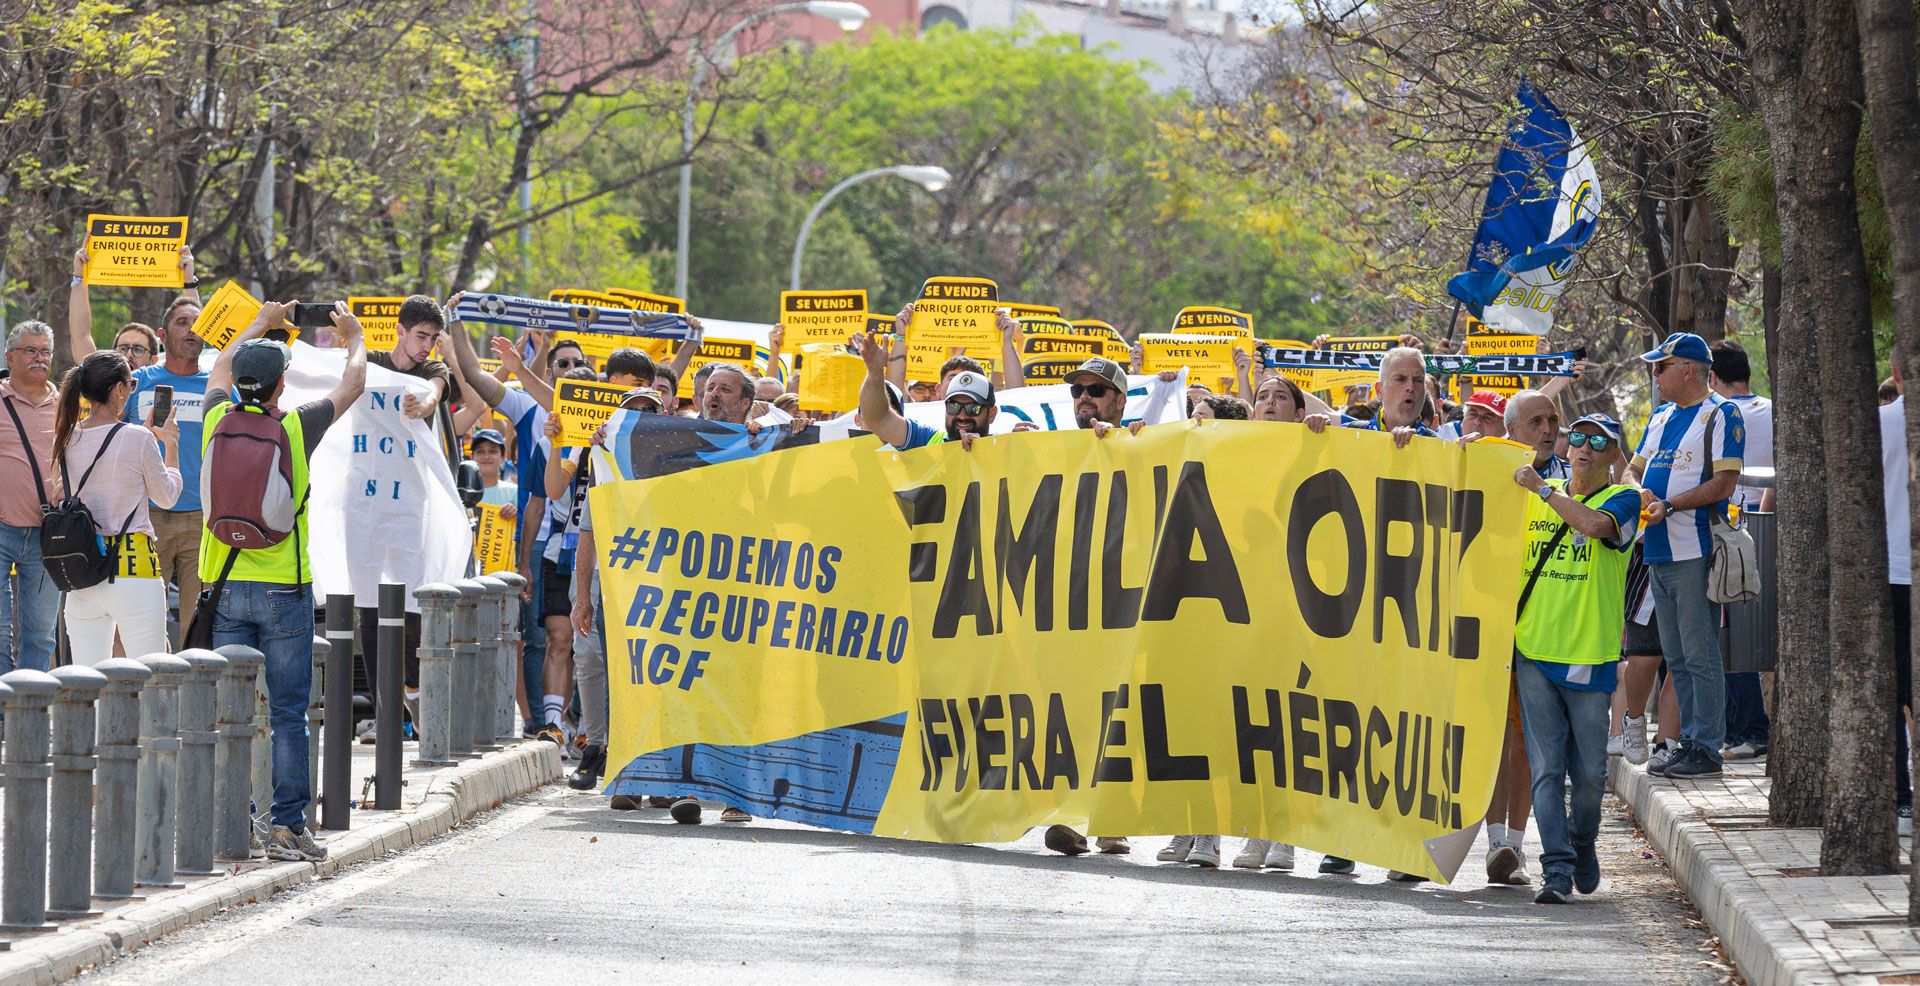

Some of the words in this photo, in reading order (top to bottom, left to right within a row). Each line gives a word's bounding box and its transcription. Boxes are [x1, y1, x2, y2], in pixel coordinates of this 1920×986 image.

[104, 223, 120, 234] SE
[124, 224, 170, 235] VENDE
[93, 241, 141, 252] ENRIQUE
[145, 242, 177, 252] ORTIZ
[112, 256, 140, 265] VETE
[141, 257, 156, 265] YA
[924, 285, 940, 297] SE
[943, 286, 989, 297] VENDE
[796, 299, 811, 309] SE
[813, 298, 854, 309] VENDE
[914, 304, 962, 314] ENRIQUE
[965, 305, 997, 314] ORTIZ
[363, 305, 377, 315] SE
[788, 316, 832, 325] ENRIQUE
[834, 315, 863, 323] ORTIZ
[934, 318, 959, 327] VETE
[963, 319, 977, 327] YA
[1180, 315, 1194, 325] SE
[1197, 314, 1239, 325] VENDE
[806, 328, 829, 336] VETE
[831, 328, 845, 336] YA
[877, 323, 892, 332] SE
[1031, 323, 1070, 335] VENDE
[1034, 341, 1048, 351] SE
[1051, 343, 1092, 353] VENDE
[1330, 343, 1344, 351] SE
[1347, 341, 1388, 350] VENDE
[1470, 340, 1508, 349] ENRIQUE
[1510, 340, 1534, 348] ORTIZ
[701, 345, 741, 357] VENDE
[1194, 350, 1209, 358] YA
[910, 355, 923, 363] YA
[1478, 357, 1564, 373] SUR
[1032, 366, 1047, 376] SE
[1481, 377, 1518, 386] VENDE
[573, 388, 590, 400] SE
[560, 405, 612, 420] ENRIQUE
[581, 422, 599, 431] VE
[484, 510, 495, 535] ORTIZ
[496, 528, 504, 540] YA
[491, 541, 502, 563] VETE
[1571, 543, 1592, 562] YA!
[608, 526, 843, 594] #PODEMOS
[625, 584, 909, 665] RECUPERARLO
[626, 638, 711, 692] HCF
[916, 692, 1080, 793] ¡FUERA
